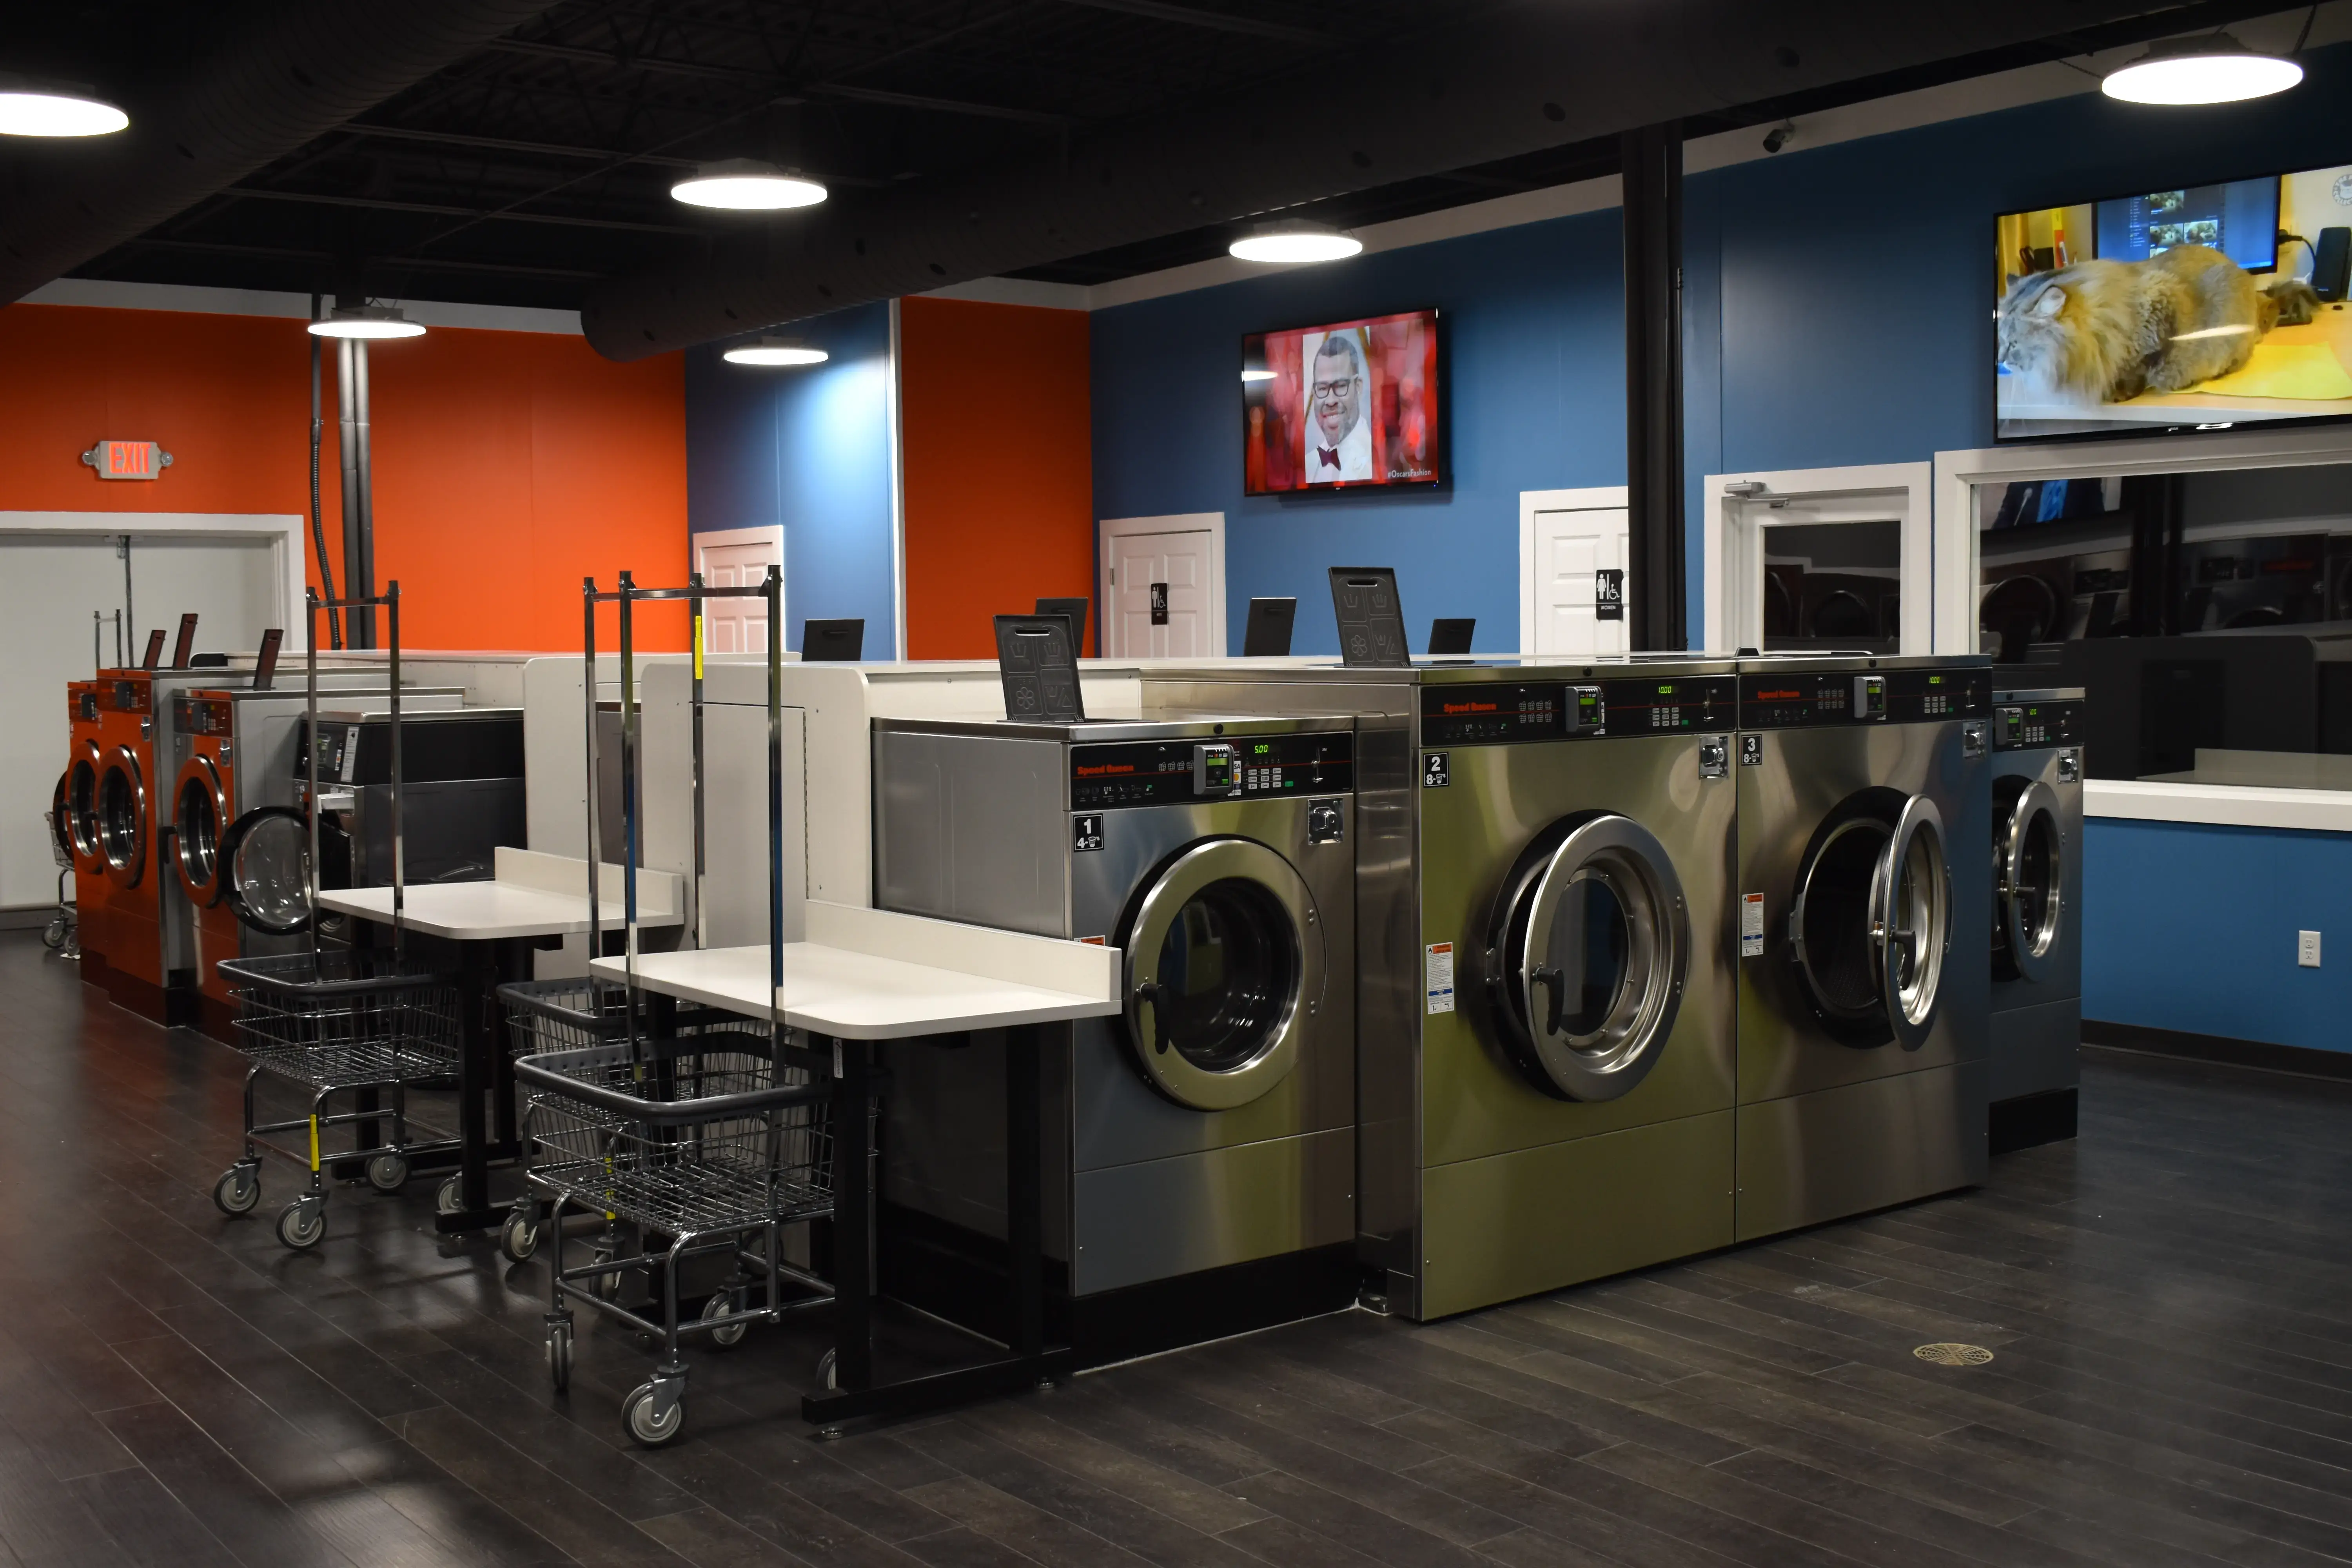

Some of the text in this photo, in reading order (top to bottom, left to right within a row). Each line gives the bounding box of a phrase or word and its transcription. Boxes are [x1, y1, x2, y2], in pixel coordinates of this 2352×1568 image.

[109, 443, 151, 474] EXIT
[1388, 468, 1431, 478] #OscarsFashion
[1255, 745, 1268, 753] 5.00
[1748, 738, 1755, 751] 3
[1078, 764, 1134, 776] Speed Queen
[1431, 756, 1440, 771] 2
[1084, 818, 1091, 834] 1
